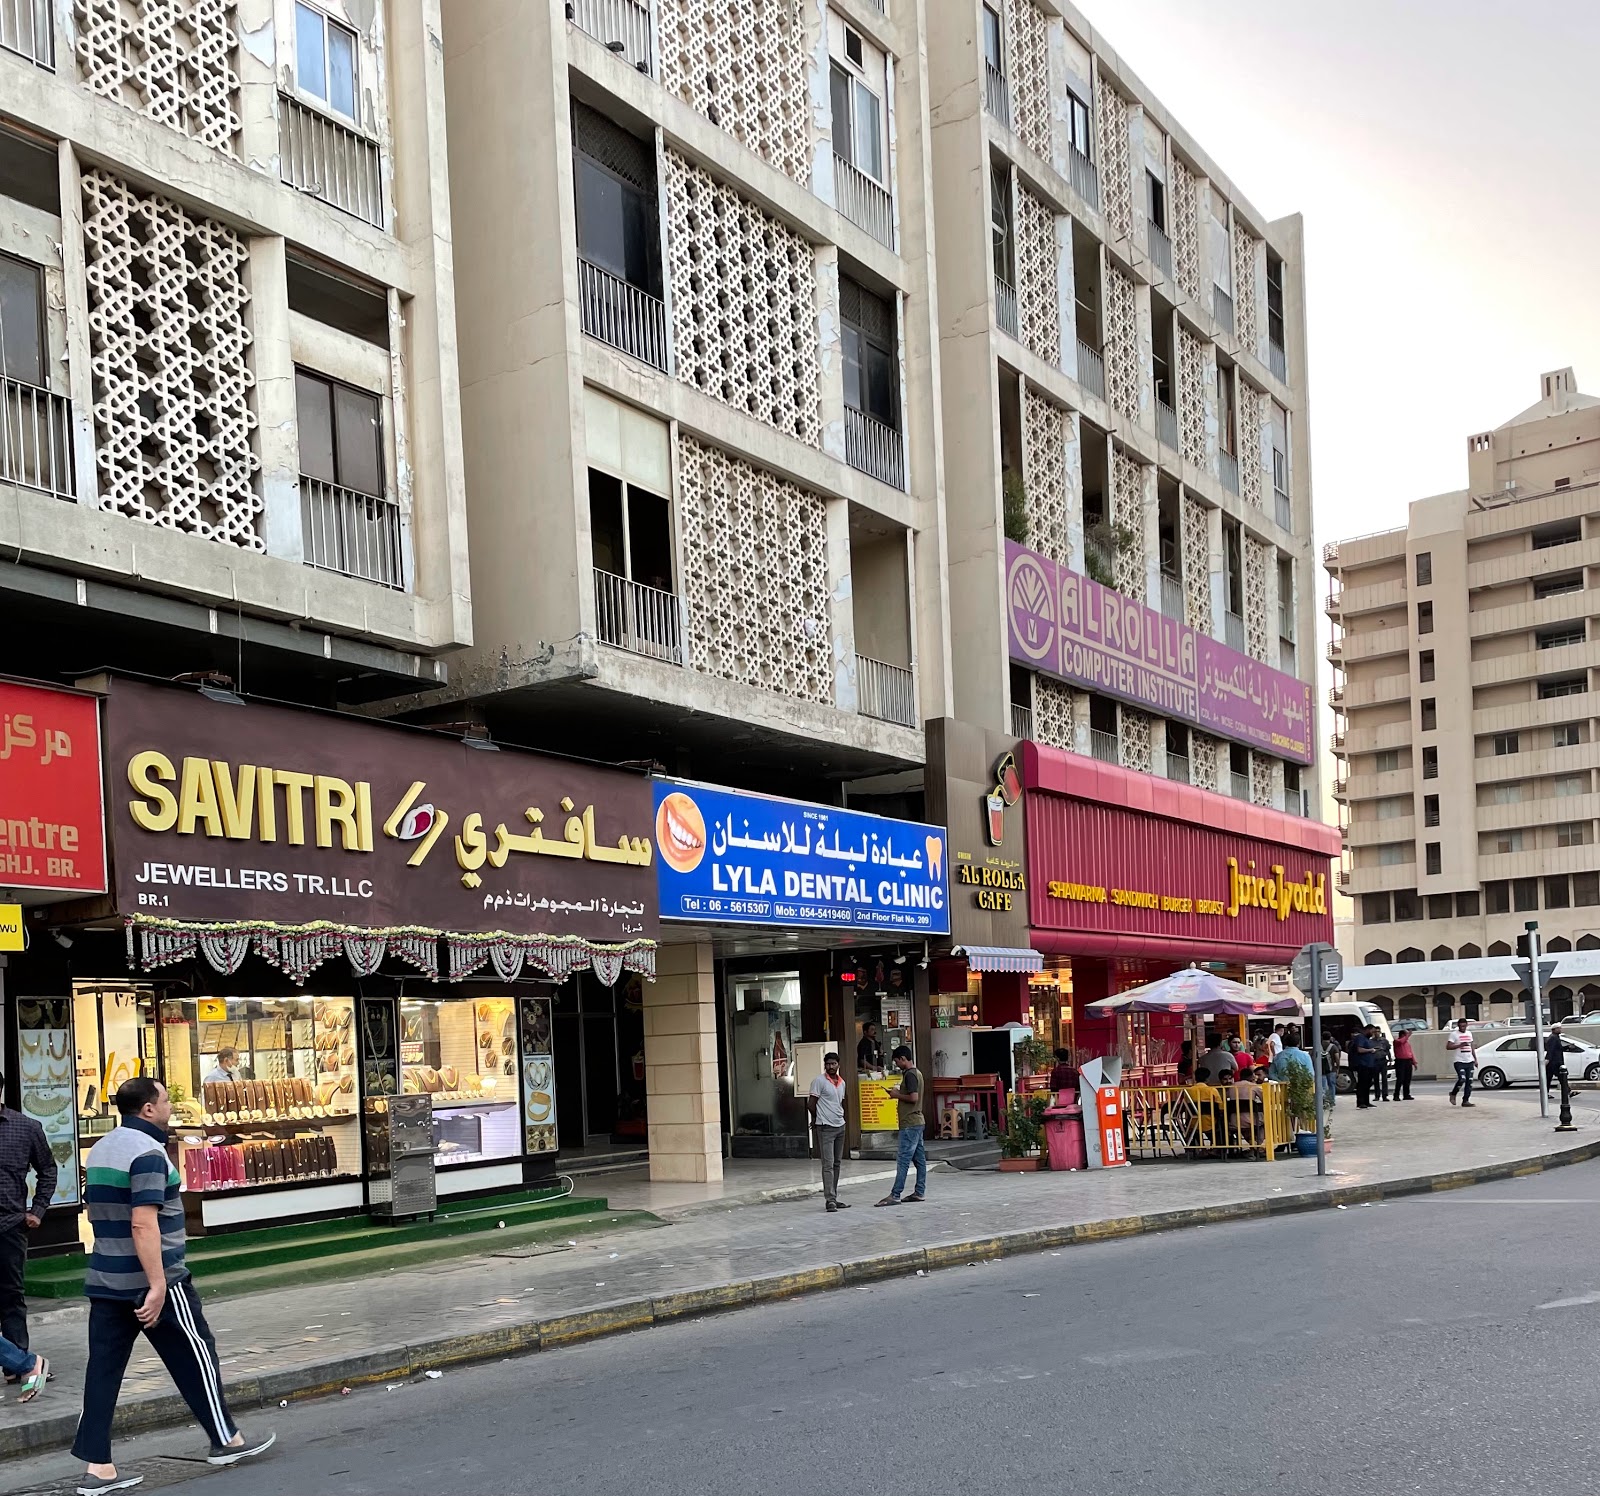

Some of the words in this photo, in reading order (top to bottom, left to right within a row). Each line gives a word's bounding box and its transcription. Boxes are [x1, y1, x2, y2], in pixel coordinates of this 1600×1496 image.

[1063, 640, 1135, 694] COMPUTER
[1138, 669, 1196, 717] INSTITUTE
[128, 750, 374, 852] SAVITRI
[803, 811, 818, 820] SINCE
[455, 796, 653, 889] سافتري
[712, 812, 811, 857] للاسنان
[815, 822, 868, 872] ليلة
[47, 857, 81, 878] BR.
[871, 832, 923, 878] عيادة
[135, 862, 289, 893] JEWELLERS
[293, 874, 374, 898] TR.LLC
[712, 863, 778, 896] LYLA
[784, 870, 872, 904] DENTAL
[878, 880, 944, 910] CLINIC
[961, 864, 980, 884] AL
[982, 867, 1026, 890] ROLLA
[138, 893, 169, 907] BR.1
[514, 892, 600, 915] المجوهرات
[601, 896, 645, 919] لتجارة
[684, 898, 700, 910] Tel
[709, 900, 722, 911] 06
[730, 901, 770, 915] 5615307
[978, 890, 1013, 911] CAFE
[1049, 880, 1108, 904] SHAWARMA
[1111, 888, 1159, 910] SANDWICH
[1161, 896, 1193, 913] BURGER
[1196, 899, 1224, 916] BROAST
[775, 905, 798, 917] Mob:
[800, 907, 851, 921] 054-5419460
[856, 911, 871, 921] 2nd
[872, 913, 890, 923] Floor
[891, 914, 904, 923] Flat
[905, 914, 917, 924] No.
[917, 915, 929, 925] 209
